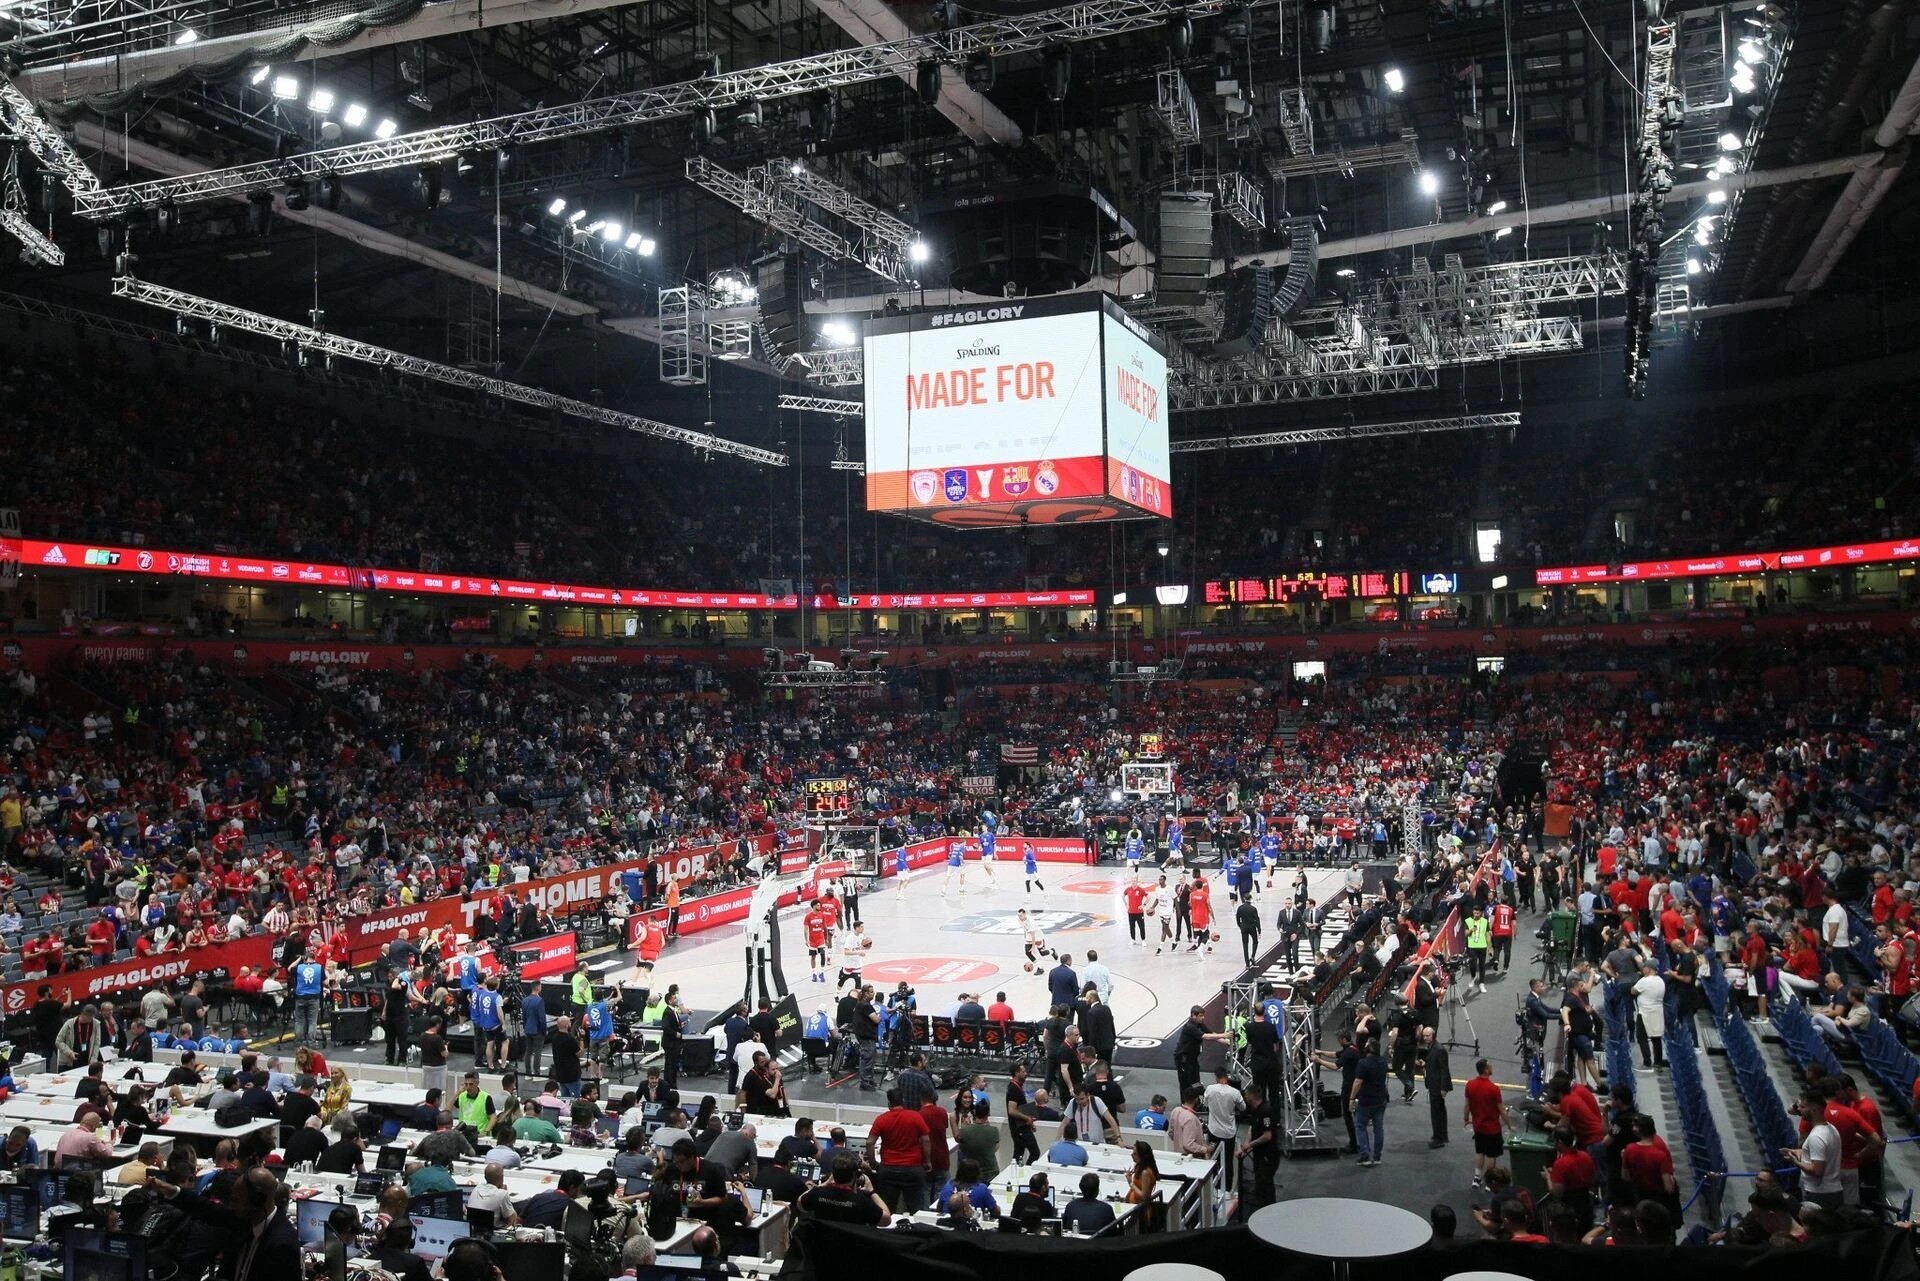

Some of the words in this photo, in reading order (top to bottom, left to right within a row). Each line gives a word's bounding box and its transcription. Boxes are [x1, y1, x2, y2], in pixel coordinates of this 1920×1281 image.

[931, 306, 1024, 327] #F4GLORY
[956, 344, 1001, 360] SPALDING
[906, 368, 988, 411] MADE
[996, 361, 1056, 403] FOR
[1117, 365, 1141, 413] MADE
[1142, 383, 1159, 424] FOR
[43, 556, 67, 564] adidas
[182, 557, 210, 565] TURKISH
[181, 564, 210, 573] AIRLINES
[1541, 632, 1604, 641] #F4GLRY
[84, 647, 113, 665] every
[116, 647, 145, 662] game
[289, 650, 370, 664] #F4GLORY
[571, 655, 618, 664] #F4GLORY
[978, 650, 1031, 658] #F4GLORY
[808, 782, 833, 793] 15:29
[966, 786, 994, 795] AXOS
[816, 797, 833, 811] 24
[838, 797, 847, 808] 24
[529, 878, 601, 910] HOME
[710, 903, 732, 915] TURKISH
[361, 910, 428, 936] #F4GLORY
[1500, 914, 1508, 925] 11
[544, 945, 572, 960] AIRLINES
[89, 959, 190, 994] #F4GLORY
[593, 1019, 602, 1027] TV
[1270, 1016, 1280, 1025] TV
[809, 1023, 819, 1032] TV
